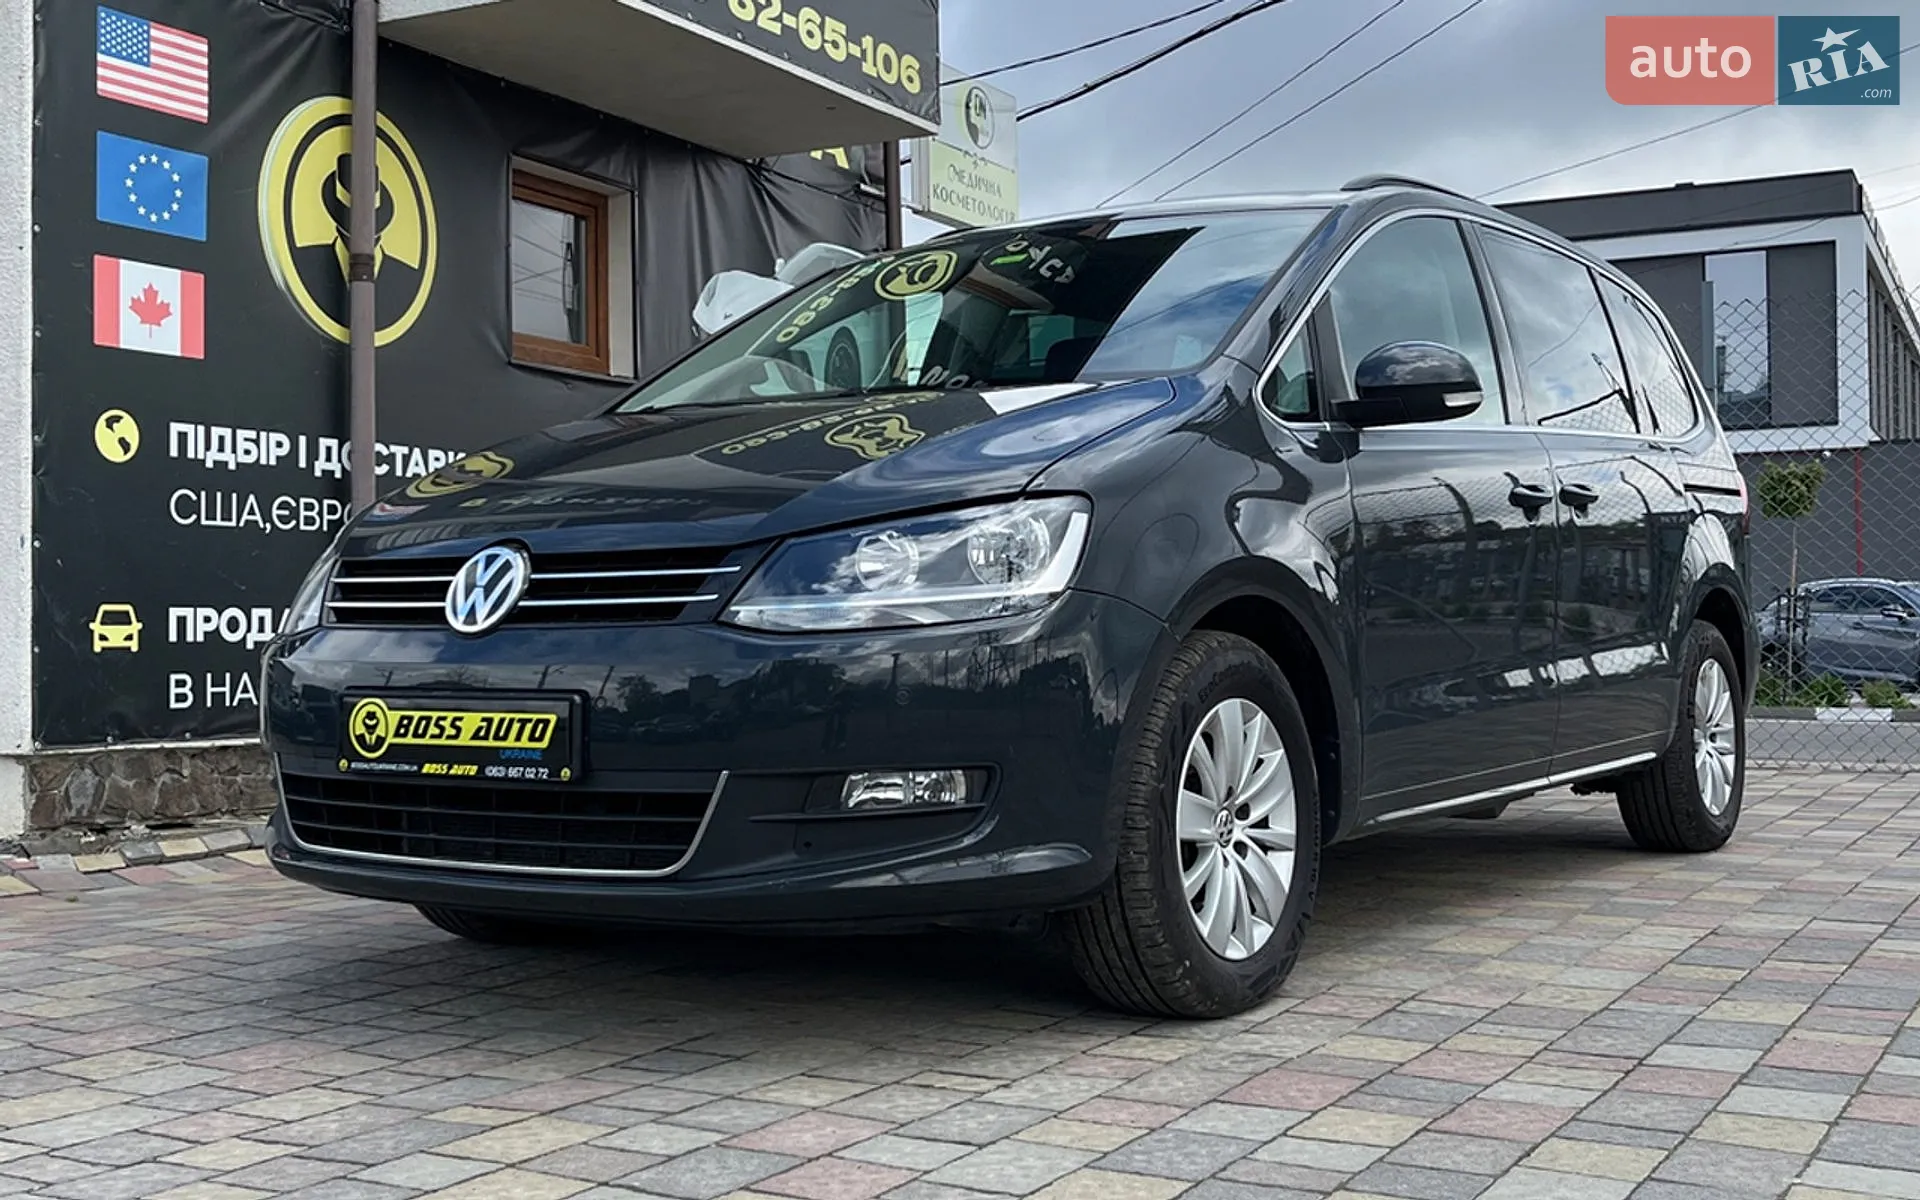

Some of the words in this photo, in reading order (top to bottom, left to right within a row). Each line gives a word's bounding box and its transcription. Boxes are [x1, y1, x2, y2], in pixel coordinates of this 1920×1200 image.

[169, 421, 292, 471] ПІДБІР
[169, 488, 352, 535] США,ЄВР
[168, 672, 194, 709] В
[392, 715, 463, 740] BOSS
[469, 717, 551, 743] AUTO
[420, 763, 449, 774] BOSS
[449, 764, 478, 776] AUTO
[537, 767, 549, 780] 72
